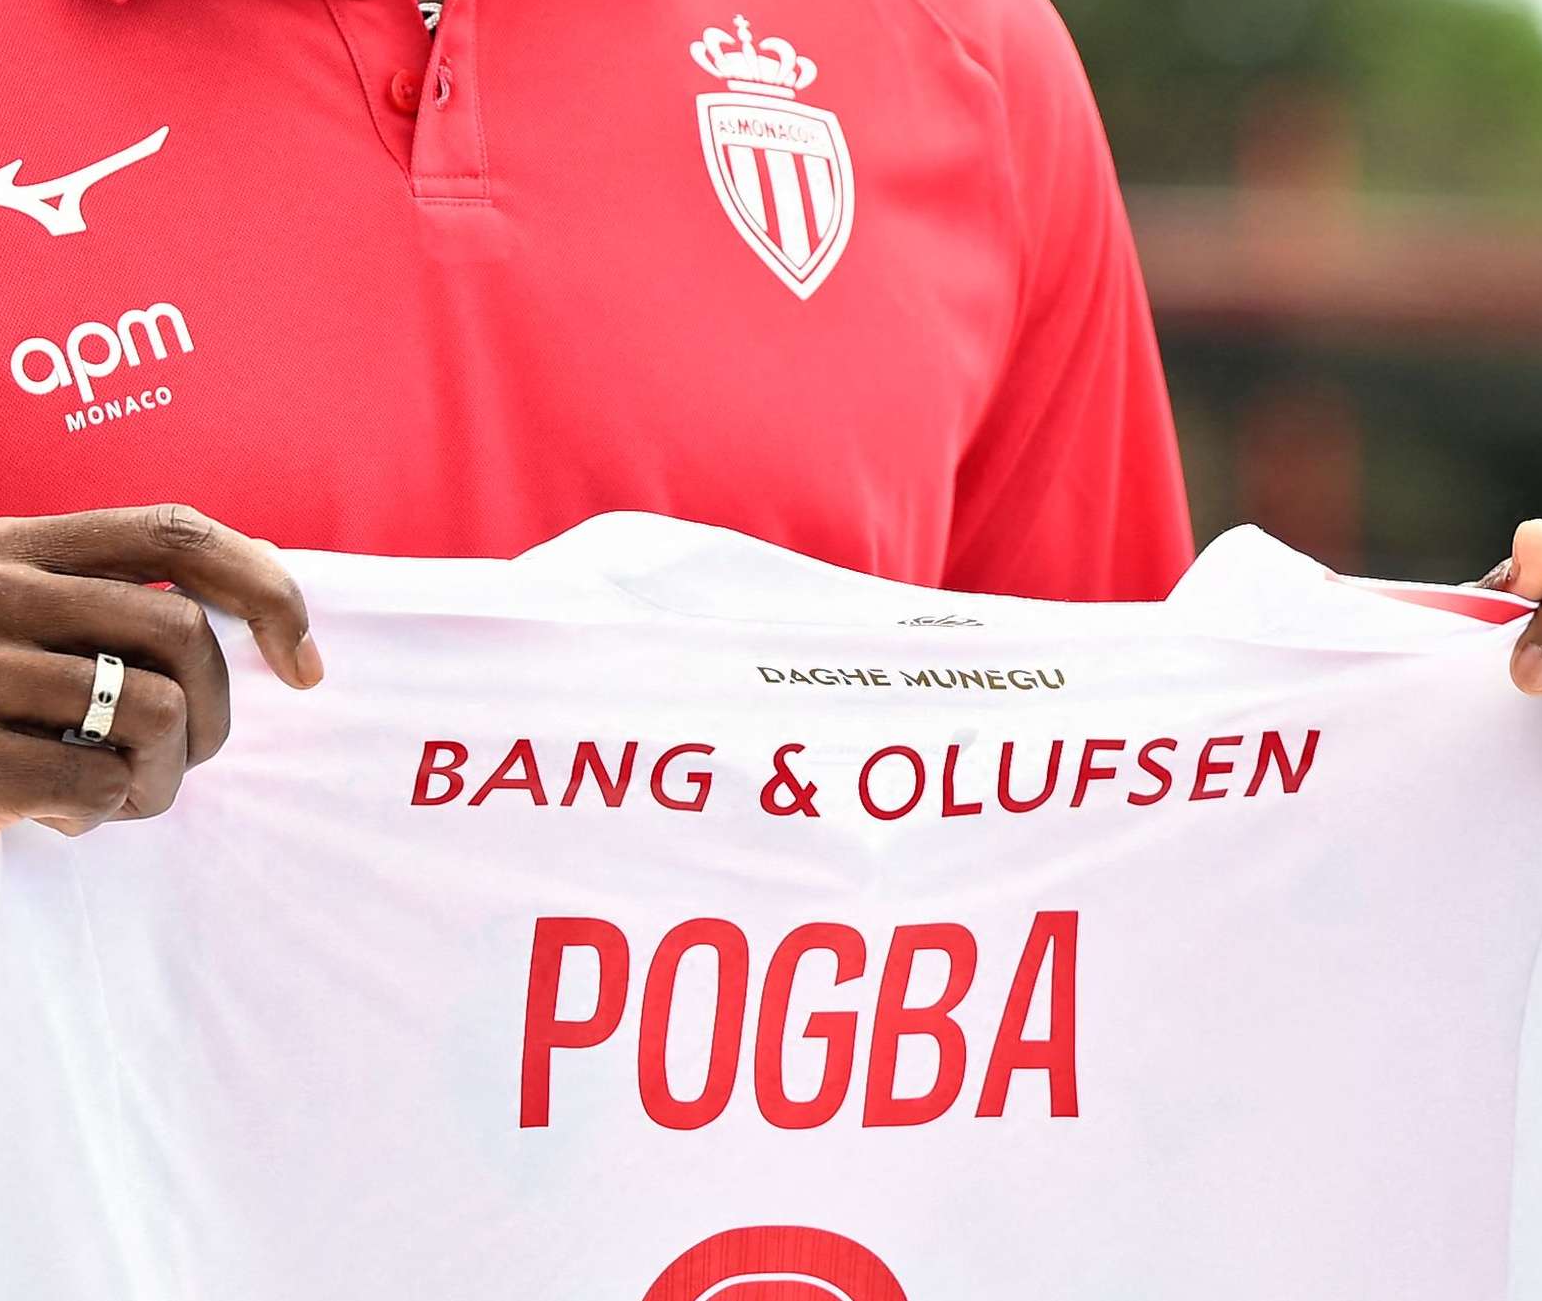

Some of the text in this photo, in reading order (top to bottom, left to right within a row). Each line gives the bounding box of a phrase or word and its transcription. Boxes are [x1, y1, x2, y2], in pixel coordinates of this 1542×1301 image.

[10, 302, 195, 404] apm
[64, 386, 173, 433] MONACO
[756, 666, 1066, 691] DAGHE MUNEGU
[410, 728, 1322, 821] BANG & OLUFSEN
[519, 909, 1080, 1132] POGBA
